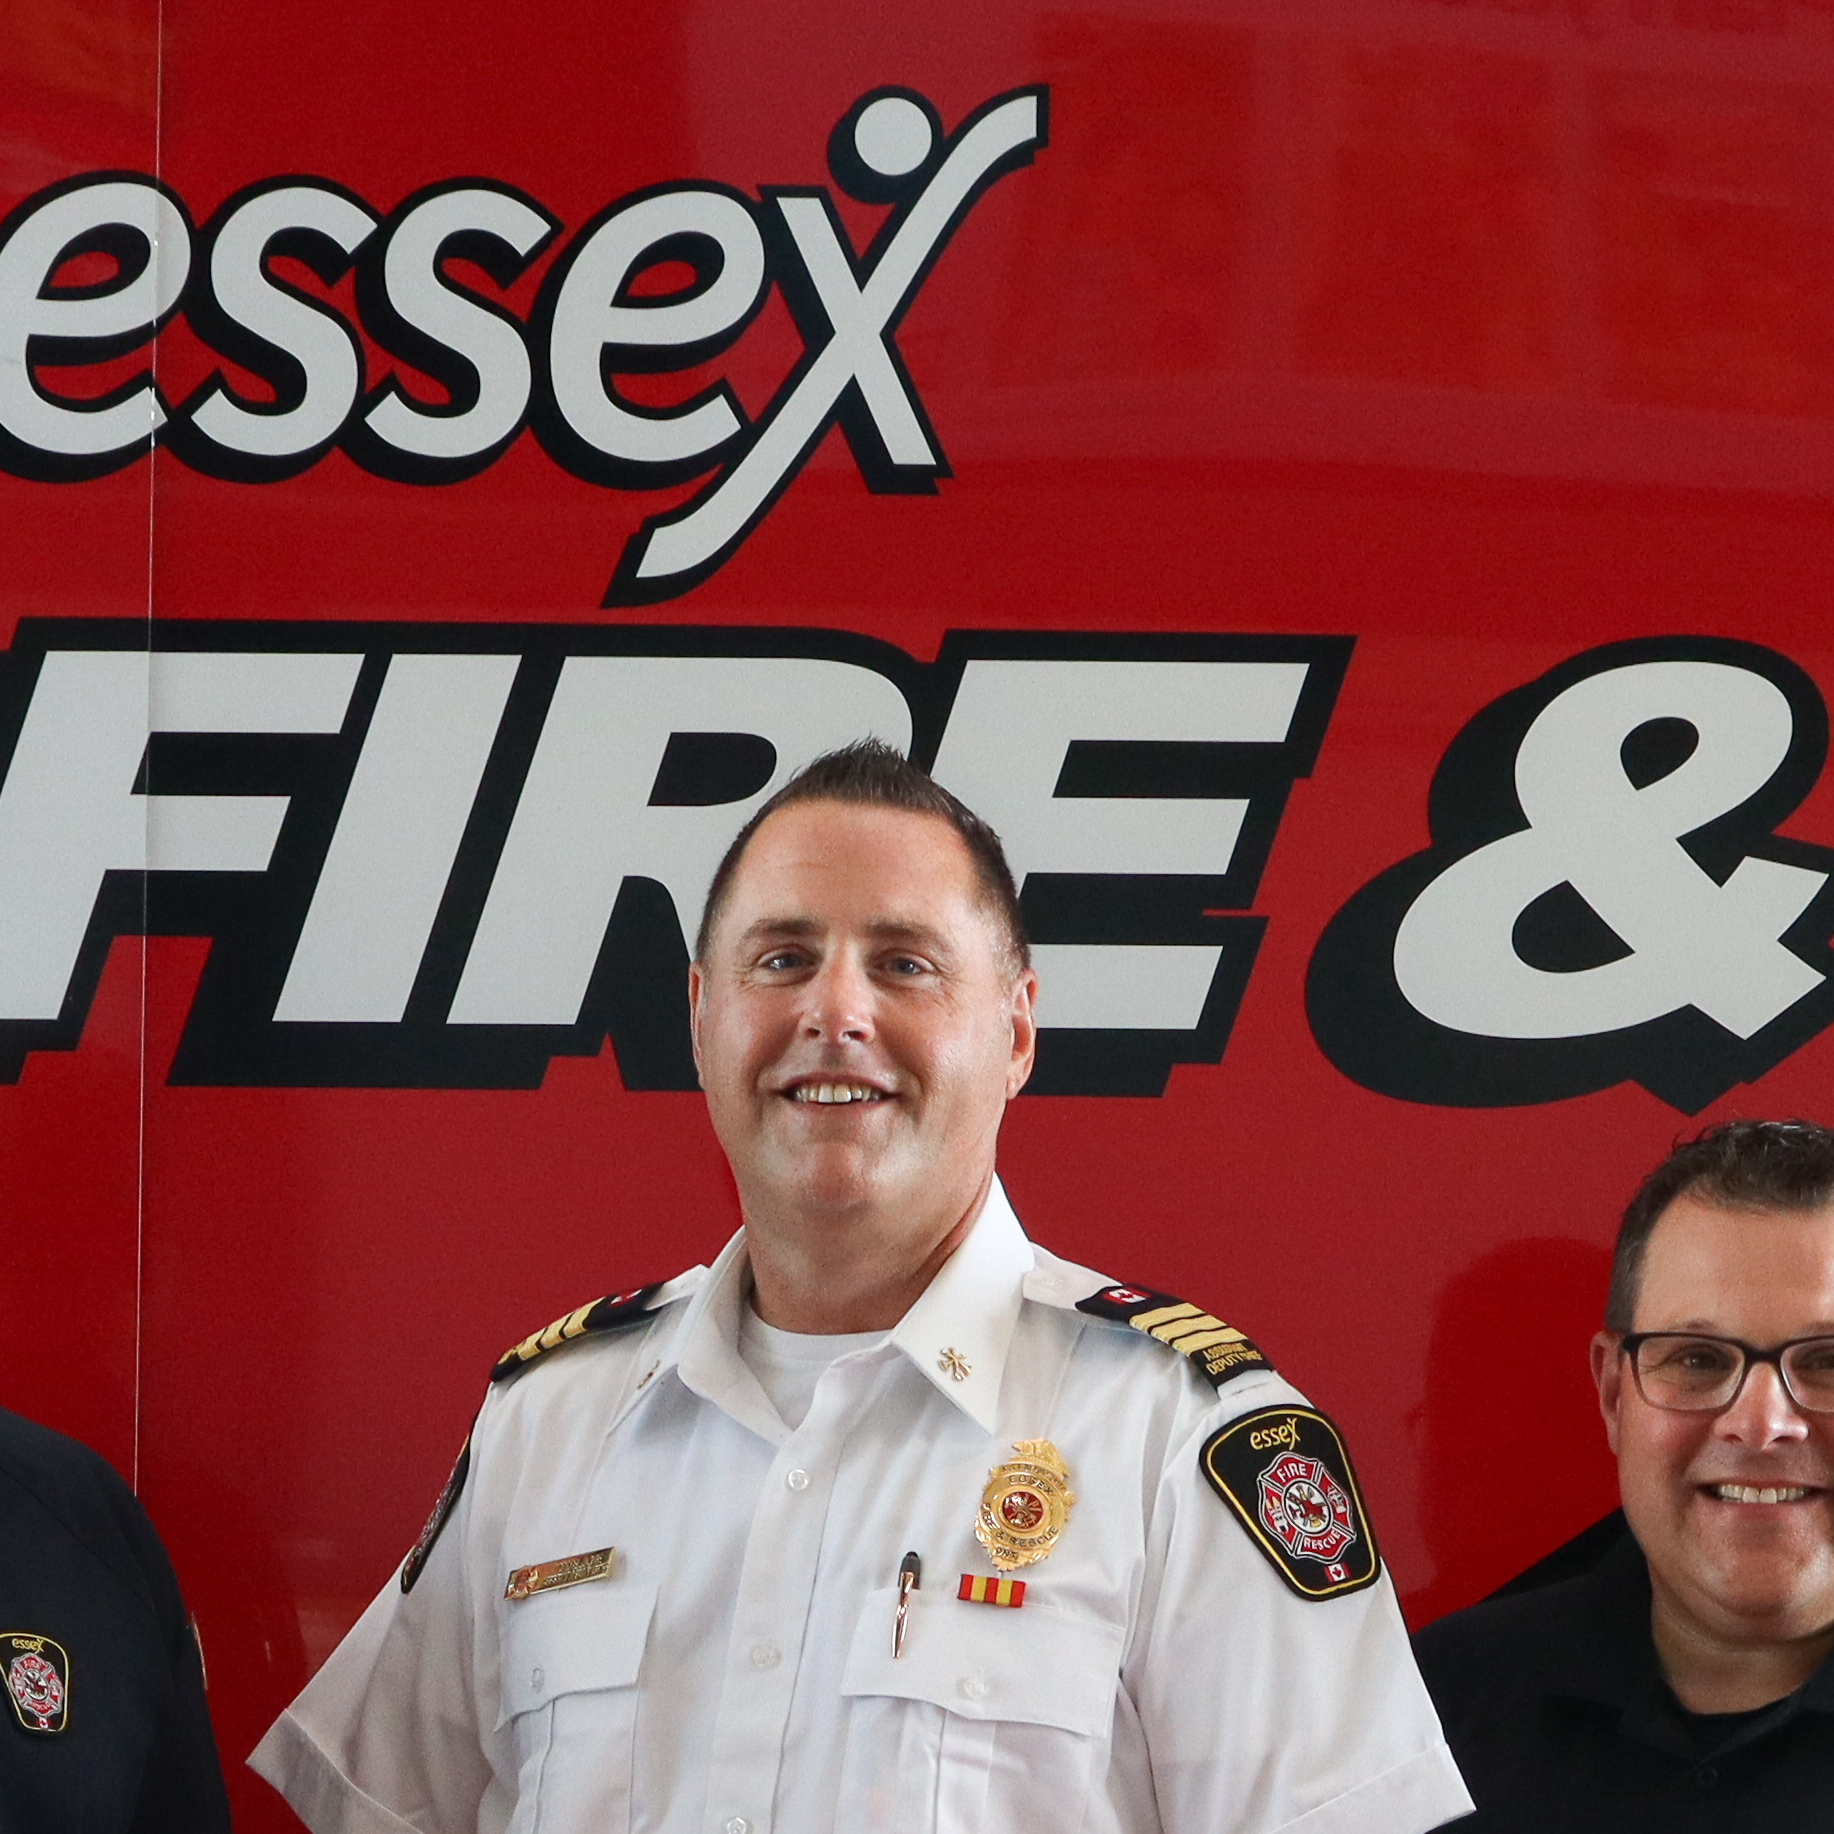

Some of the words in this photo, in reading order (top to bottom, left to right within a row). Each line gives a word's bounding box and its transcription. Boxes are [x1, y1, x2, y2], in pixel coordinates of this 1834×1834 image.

[1394, 660, 1831, 1042] &
[1250, 1417, 1300, 1451] essex
[1276, 1462, 1307, 1482] FIRE
[1303, 1530, 1341, 1551] RESCUE
[12, 1638, 44, 1654] essex
